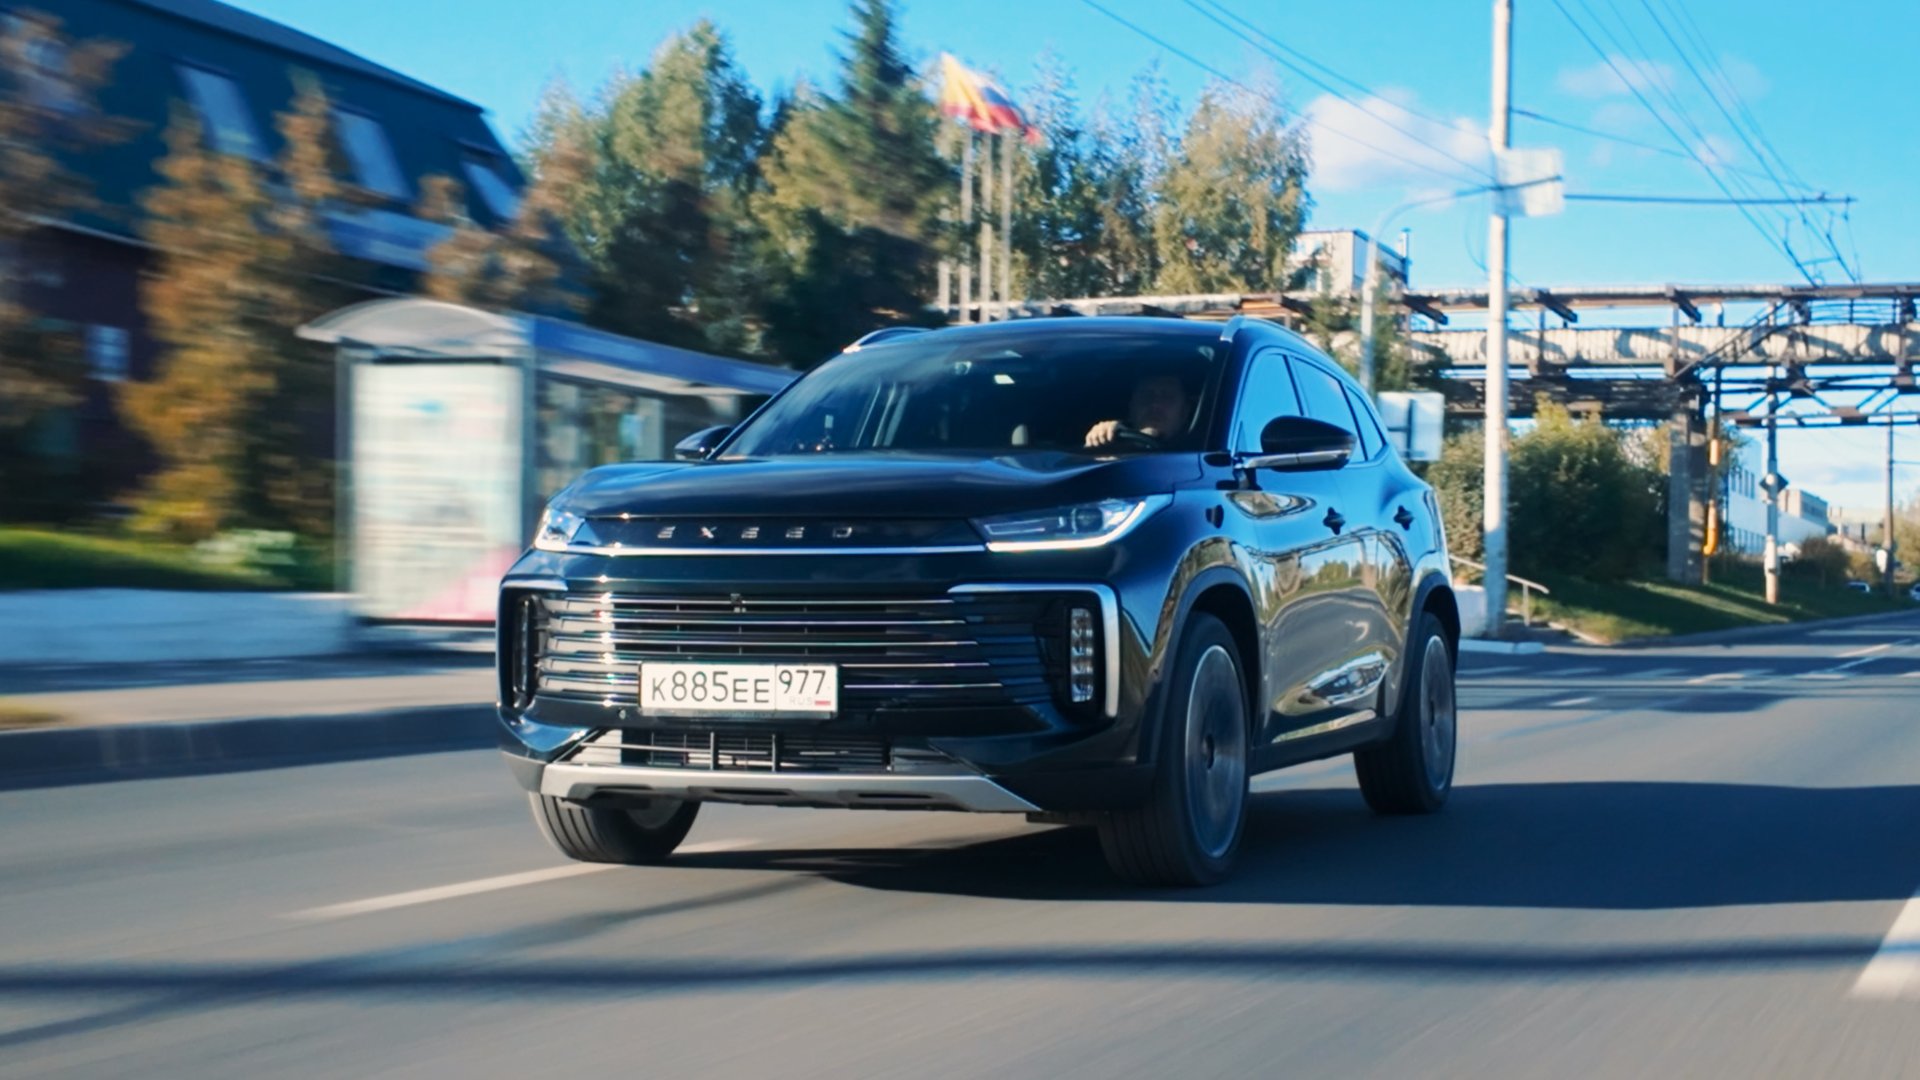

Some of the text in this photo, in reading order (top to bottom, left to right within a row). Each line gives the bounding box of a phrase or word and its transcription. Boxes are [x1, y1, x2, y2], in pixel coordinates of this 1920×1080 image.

[657, 526, 852, 539] EXEED
[652, 669, 827, 703] K885EE 977
[789, 697, 813, 705] RUS
